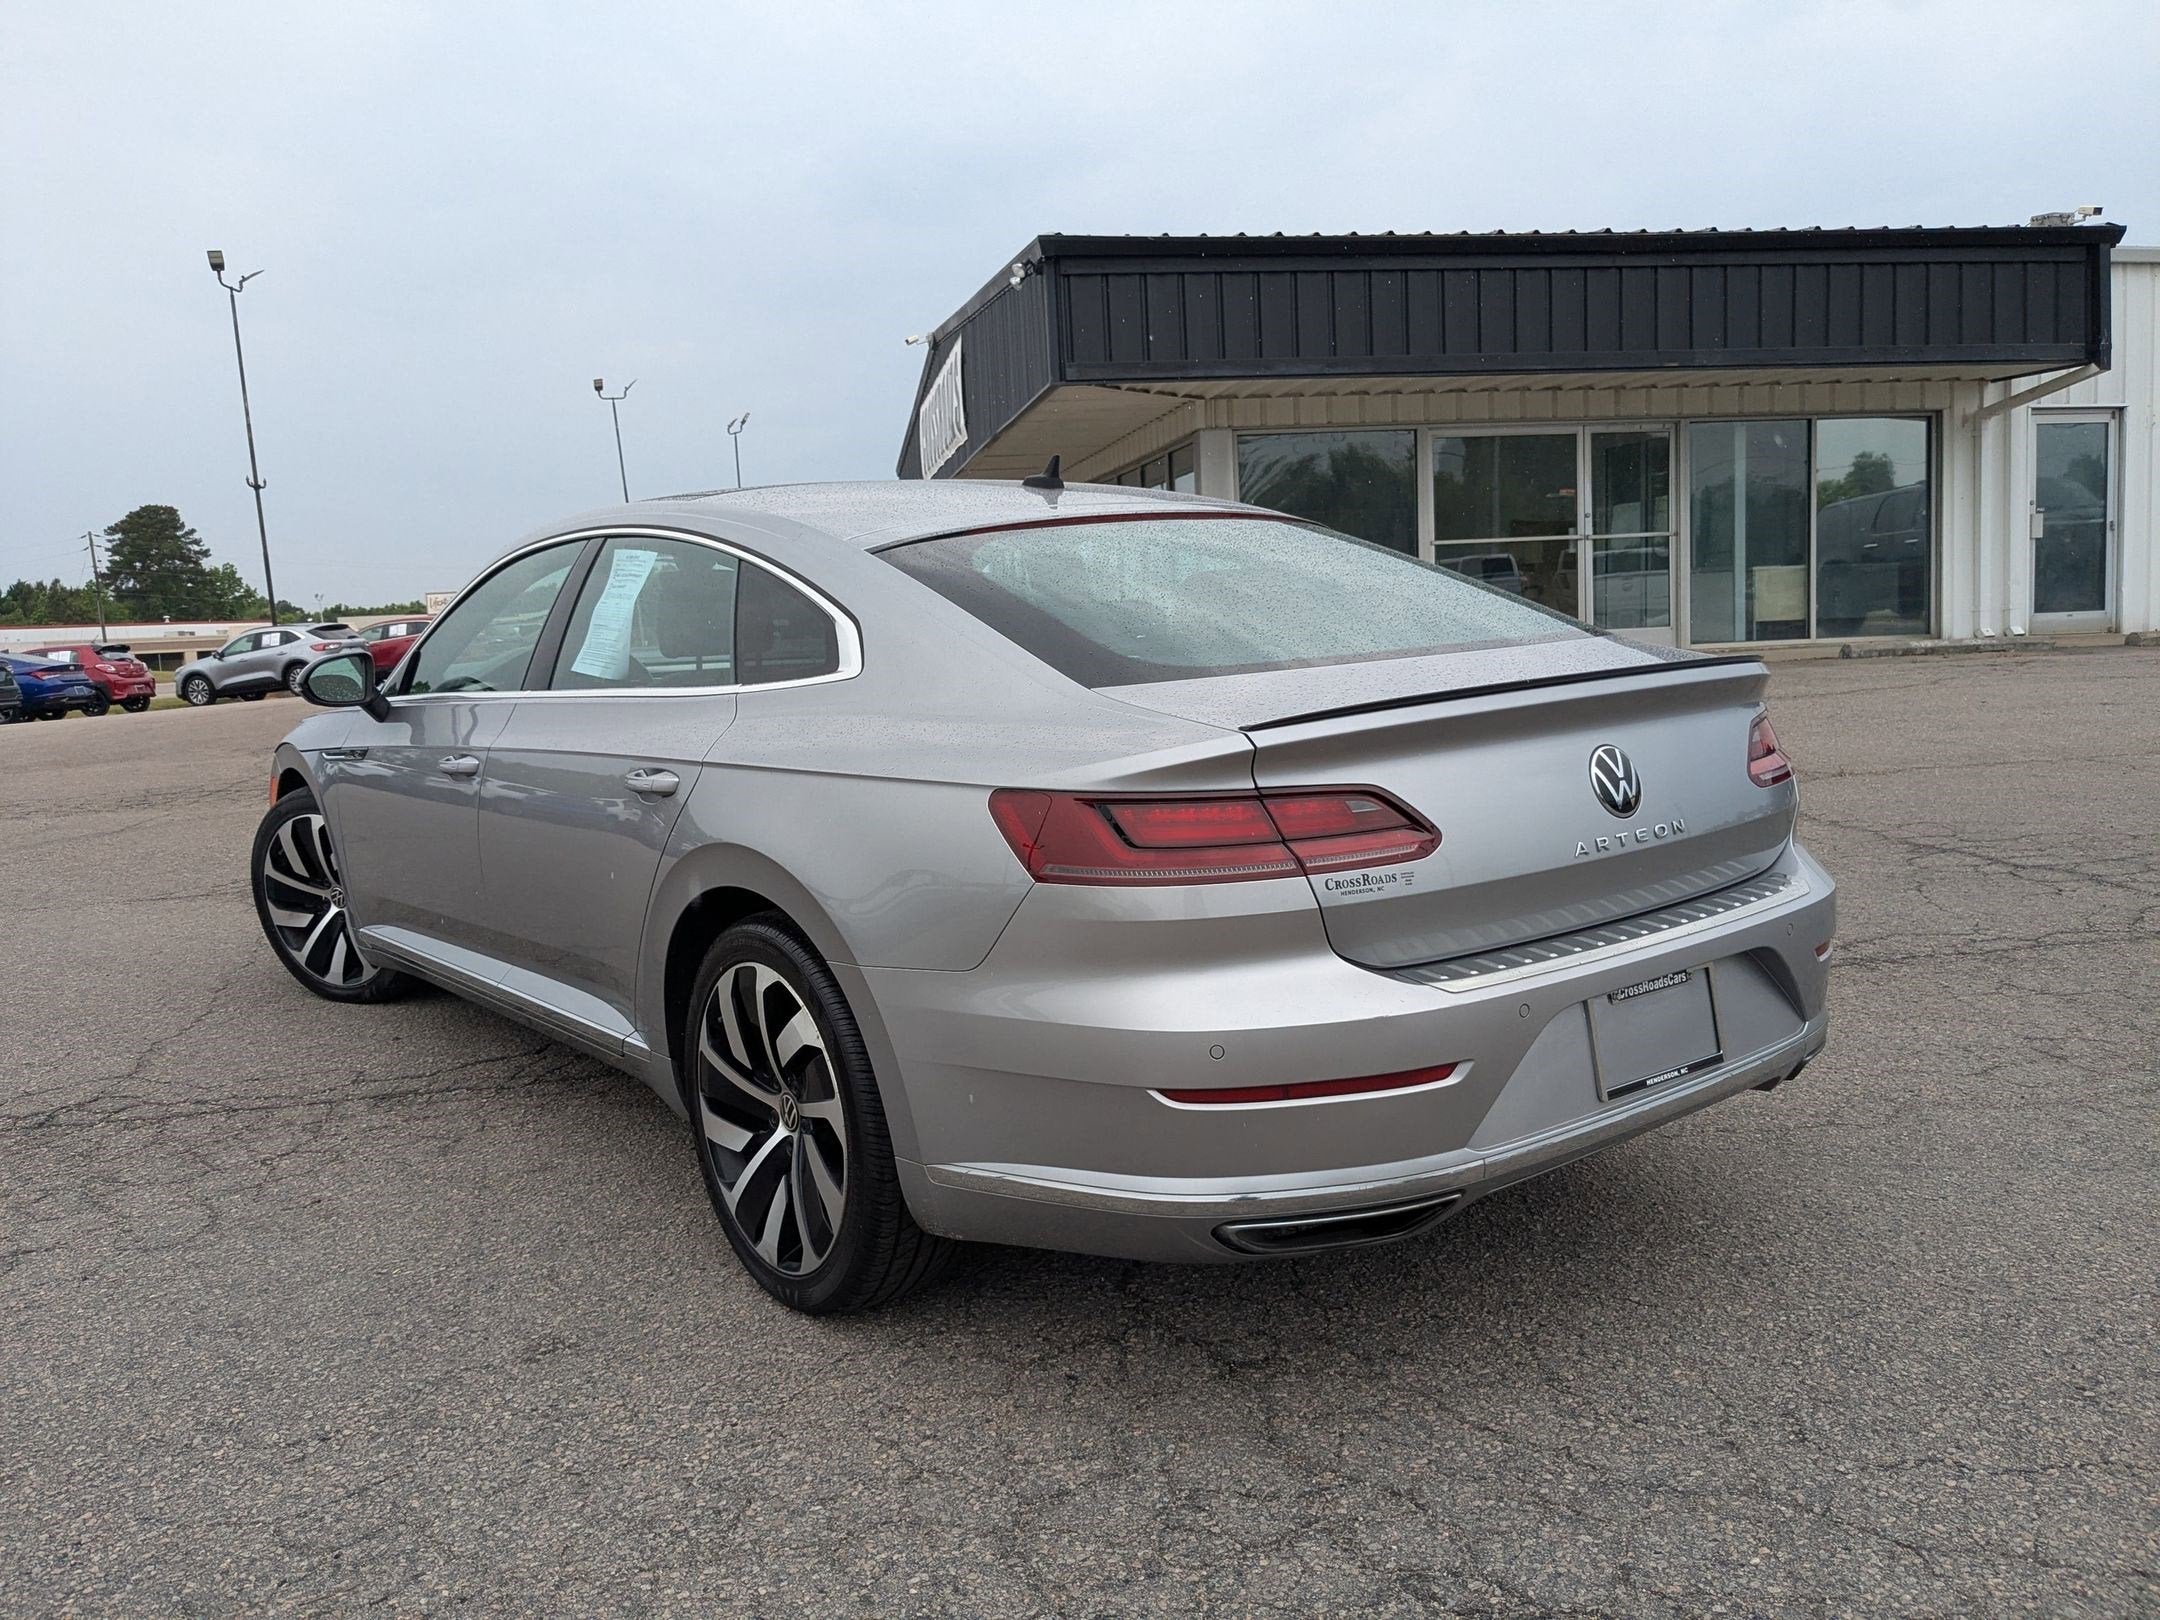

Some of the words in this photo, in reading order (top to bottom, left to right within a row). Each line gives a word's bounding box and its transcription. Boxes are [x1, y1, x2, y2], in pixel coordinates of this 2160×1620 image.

[1575, 818, 1686, 857] ARTEON
[1340, 887, 1375, 897] HENDERSON,
[1618, 972, 1687, 999] CrossRoadsCars
